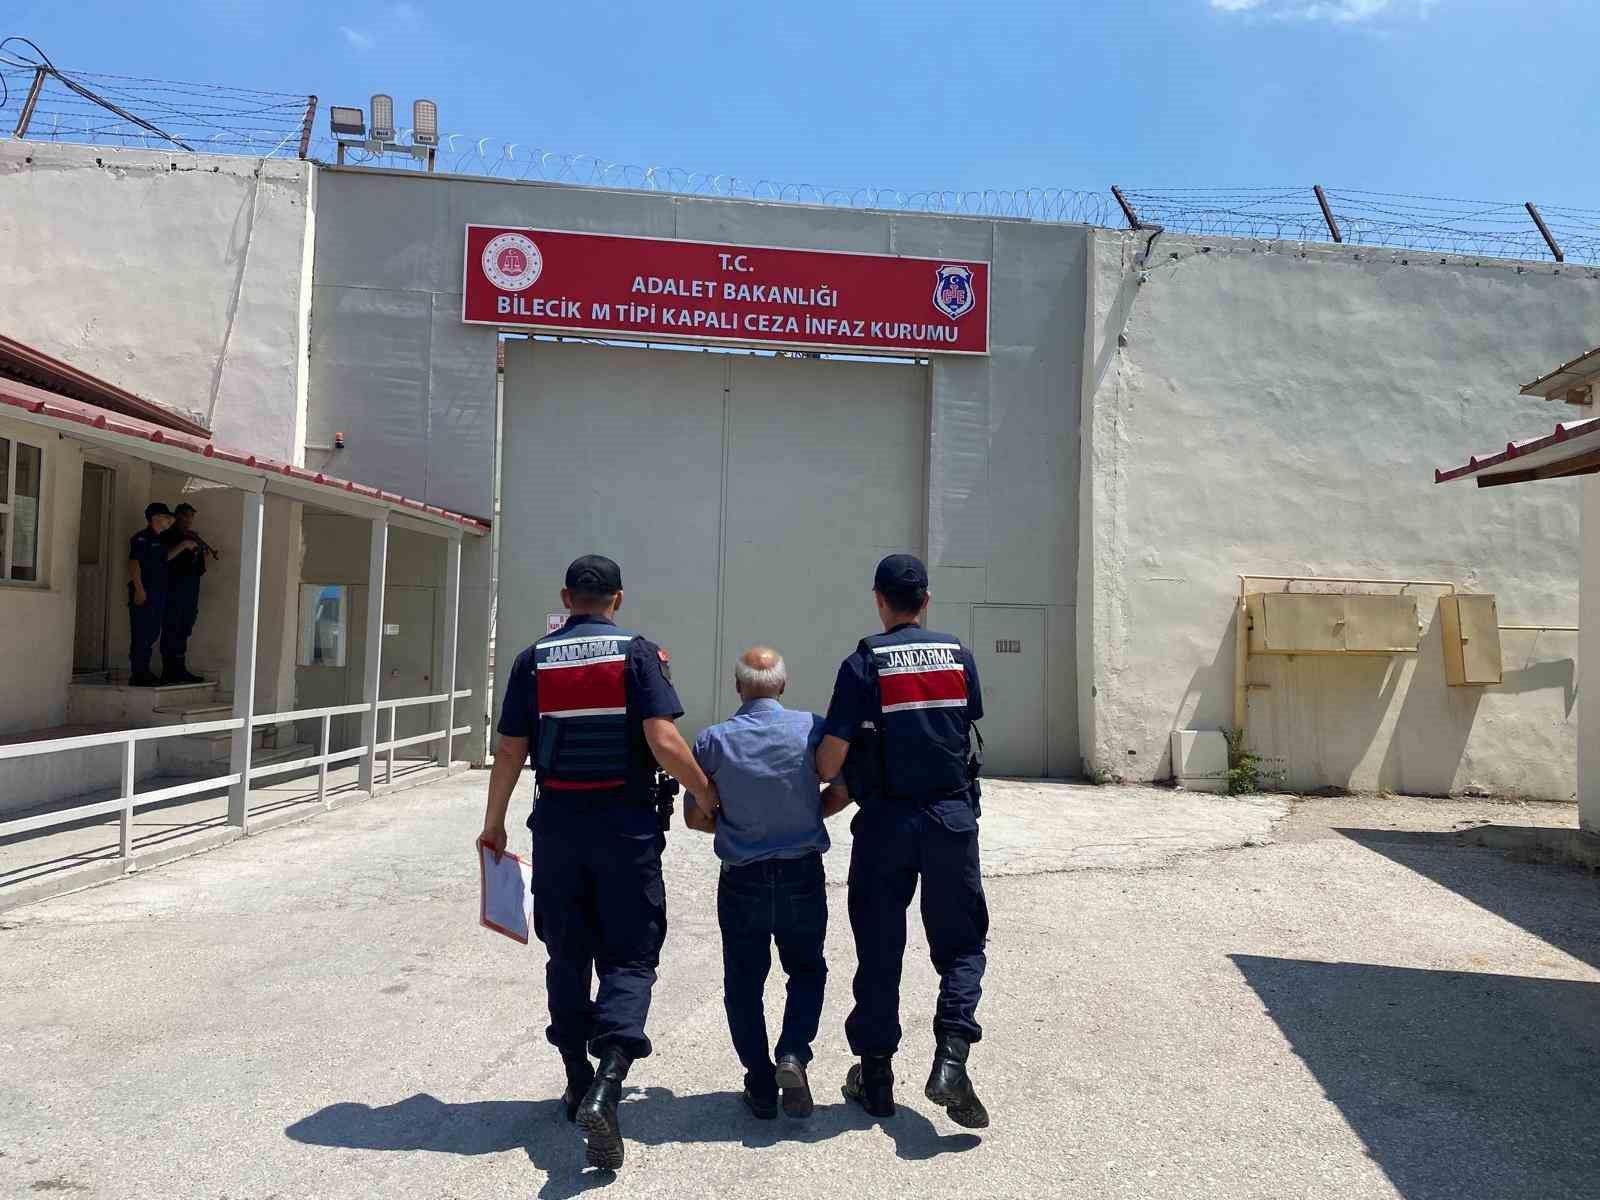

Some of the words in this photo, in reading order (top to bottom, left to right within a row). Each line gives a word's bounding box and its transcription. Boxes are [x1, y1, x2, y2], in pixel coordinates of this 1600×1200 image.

[719, 254, 754, 272] T.C.
[632, 276, 717, 298] ADALET
[723, 283, 837, 307] BAKANLIĞI
[497, 293, 582, 319] BİLECİK
[591, 303, 610, 321] M
[616, 302, 656, 324] TİPİ
[662, 308, 738, 329] KAPALI
[744, 313, 799, 334] CEZA
[805, 314, 865, 338] İNFAZ
[871, 321, 959, 342] KURUMU
[546, 640, 619, 663] JANDARMA
[887, 649, 955, 667] JANDARMA
